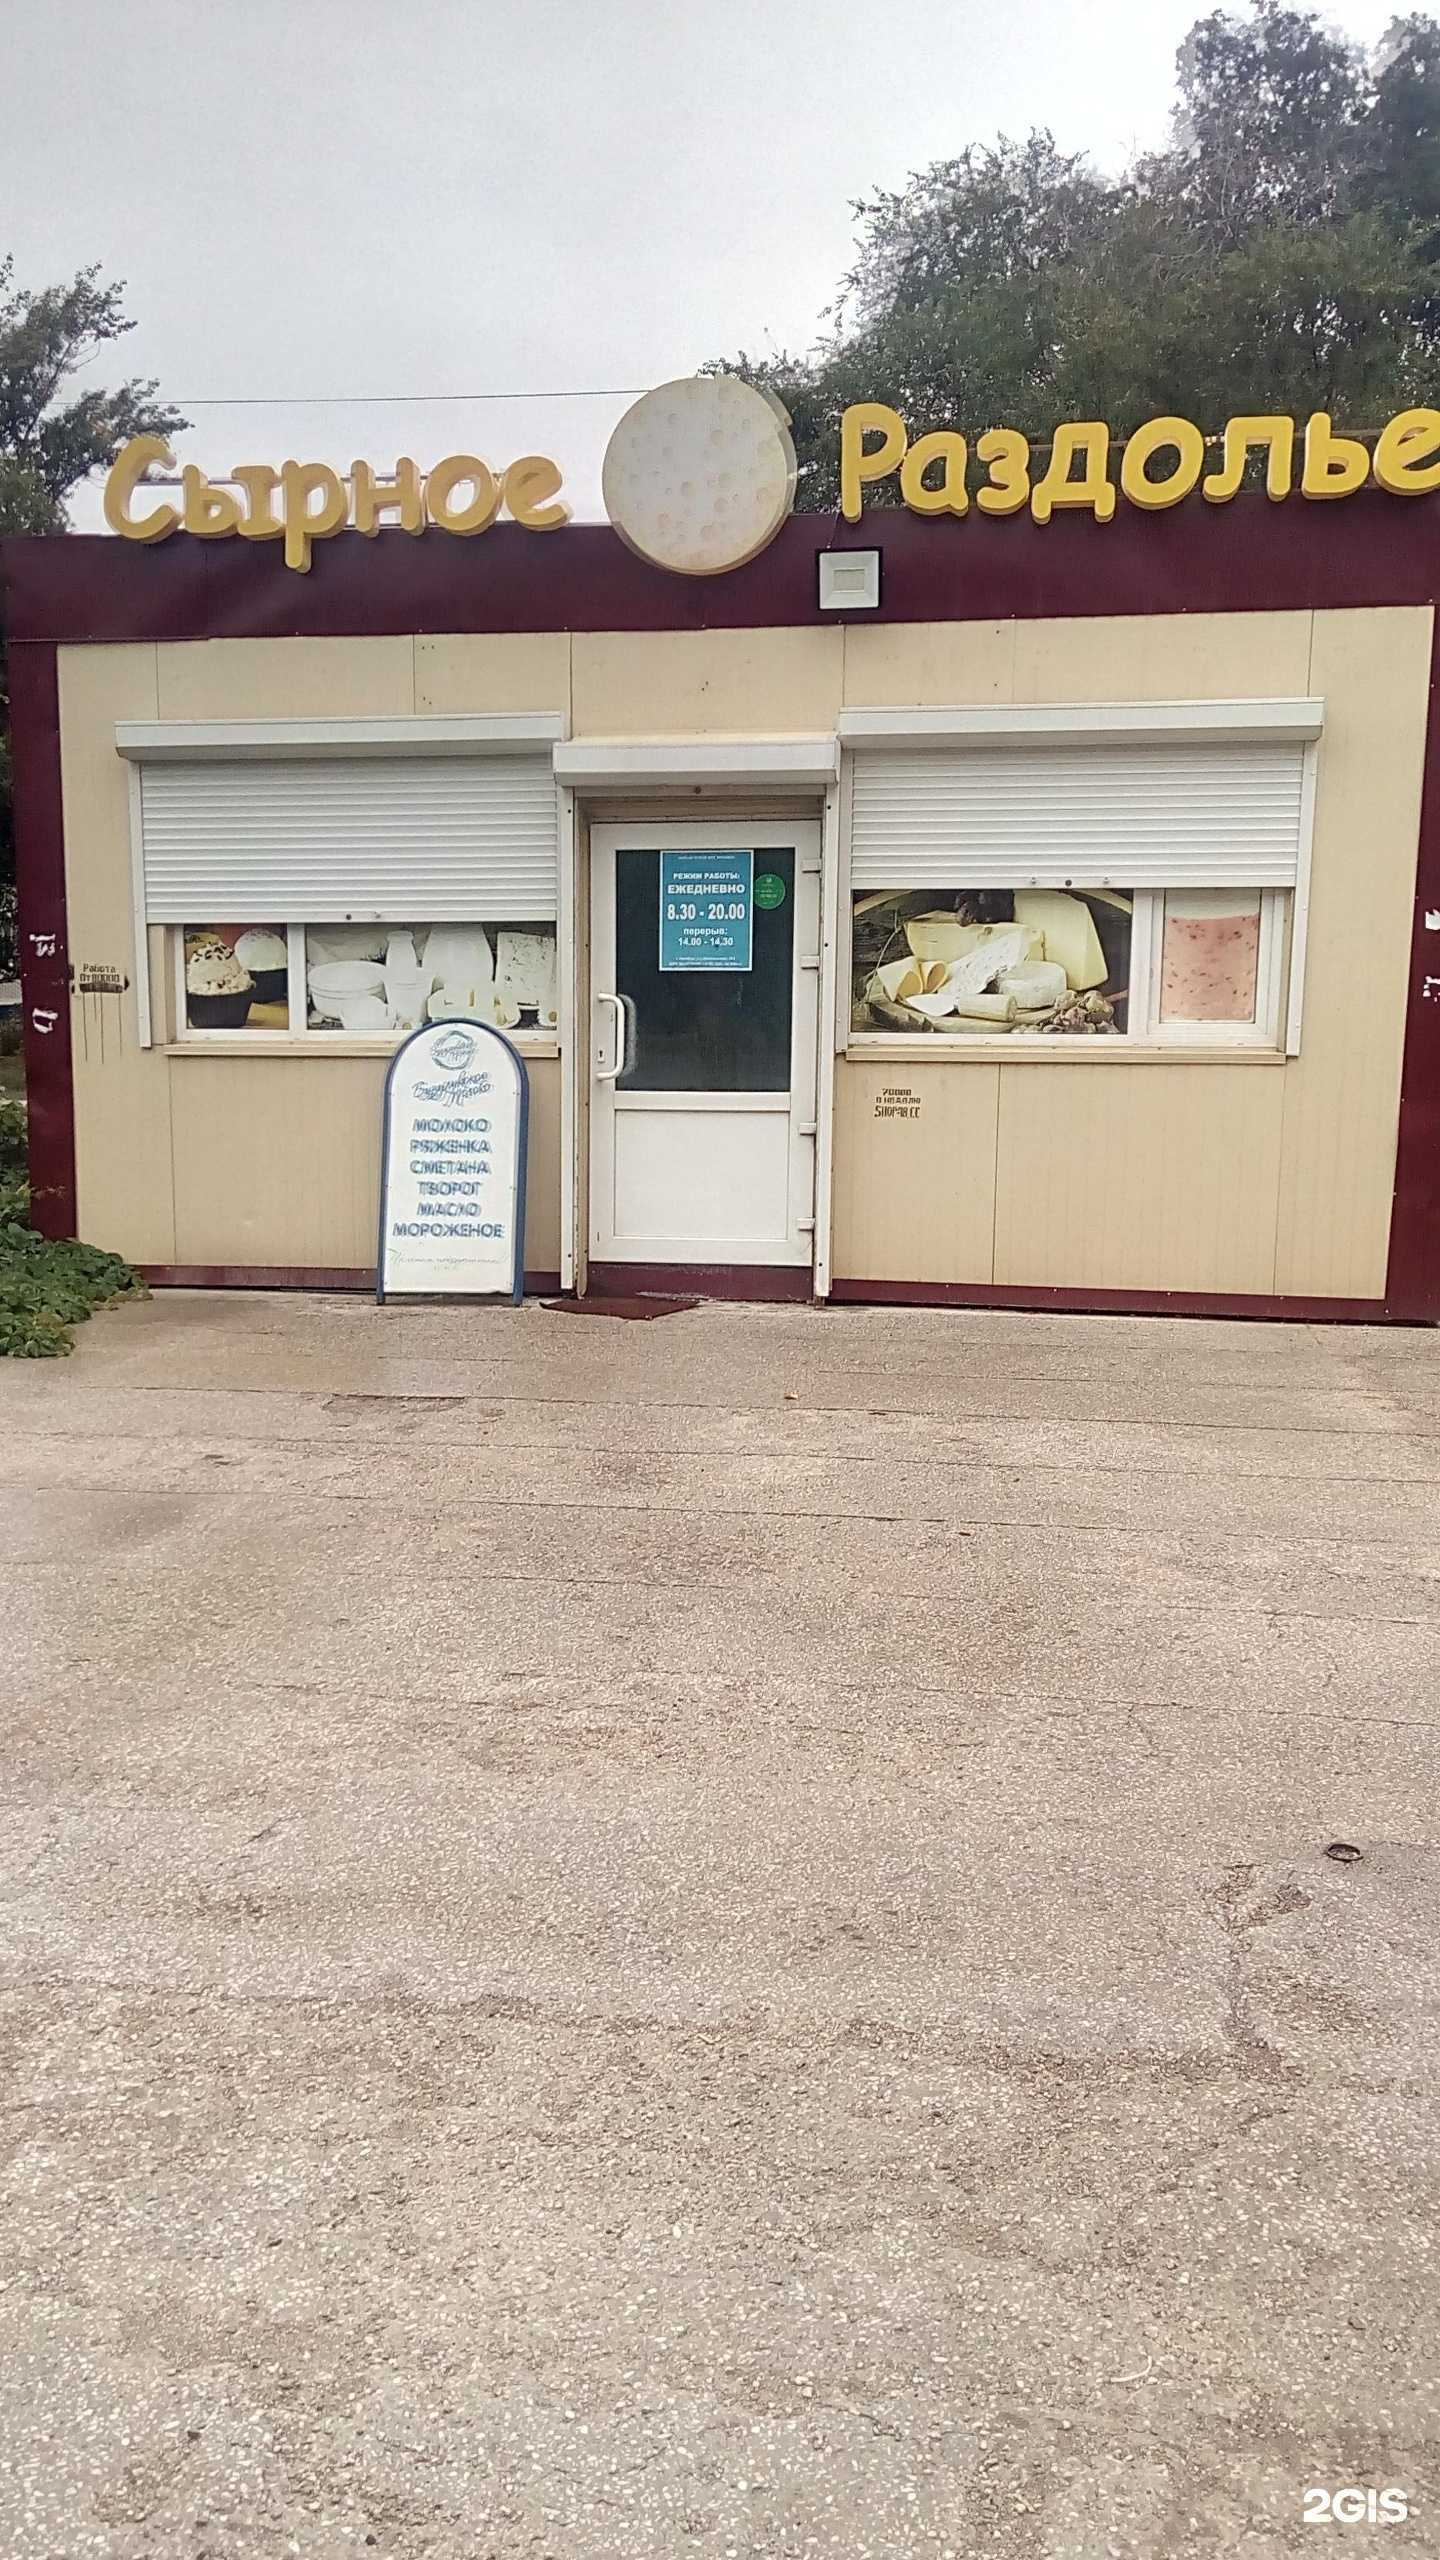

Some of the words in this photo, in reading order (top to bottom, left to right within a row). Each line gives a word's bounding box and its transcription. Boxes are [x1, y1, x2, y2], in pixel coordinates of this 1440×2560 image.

[104, 434, 570, 572] Сырное
[840, 402, 1440, 523] Раздолье
[667, 884, 746, 895] ЕЖЕДНЕВНО
[667, 904, 696, 920] 8.30
[708, 903, 745, 920] 20.00
[683, 927, 728, 937] перерыв:
[412, 1118, 492, 1133] МОЛОКО
[410, 1139, 492, 1154] РЯЖЕНКА
[410, 1160, 492, 1175] СМЕТАНА
[416, 1181, 483, 1196] ТВОРОГ
[416, 1202, 482, 1217] МАСЛО
[392, 1222, 505, 1238] МОРОЖЕНОЕ
